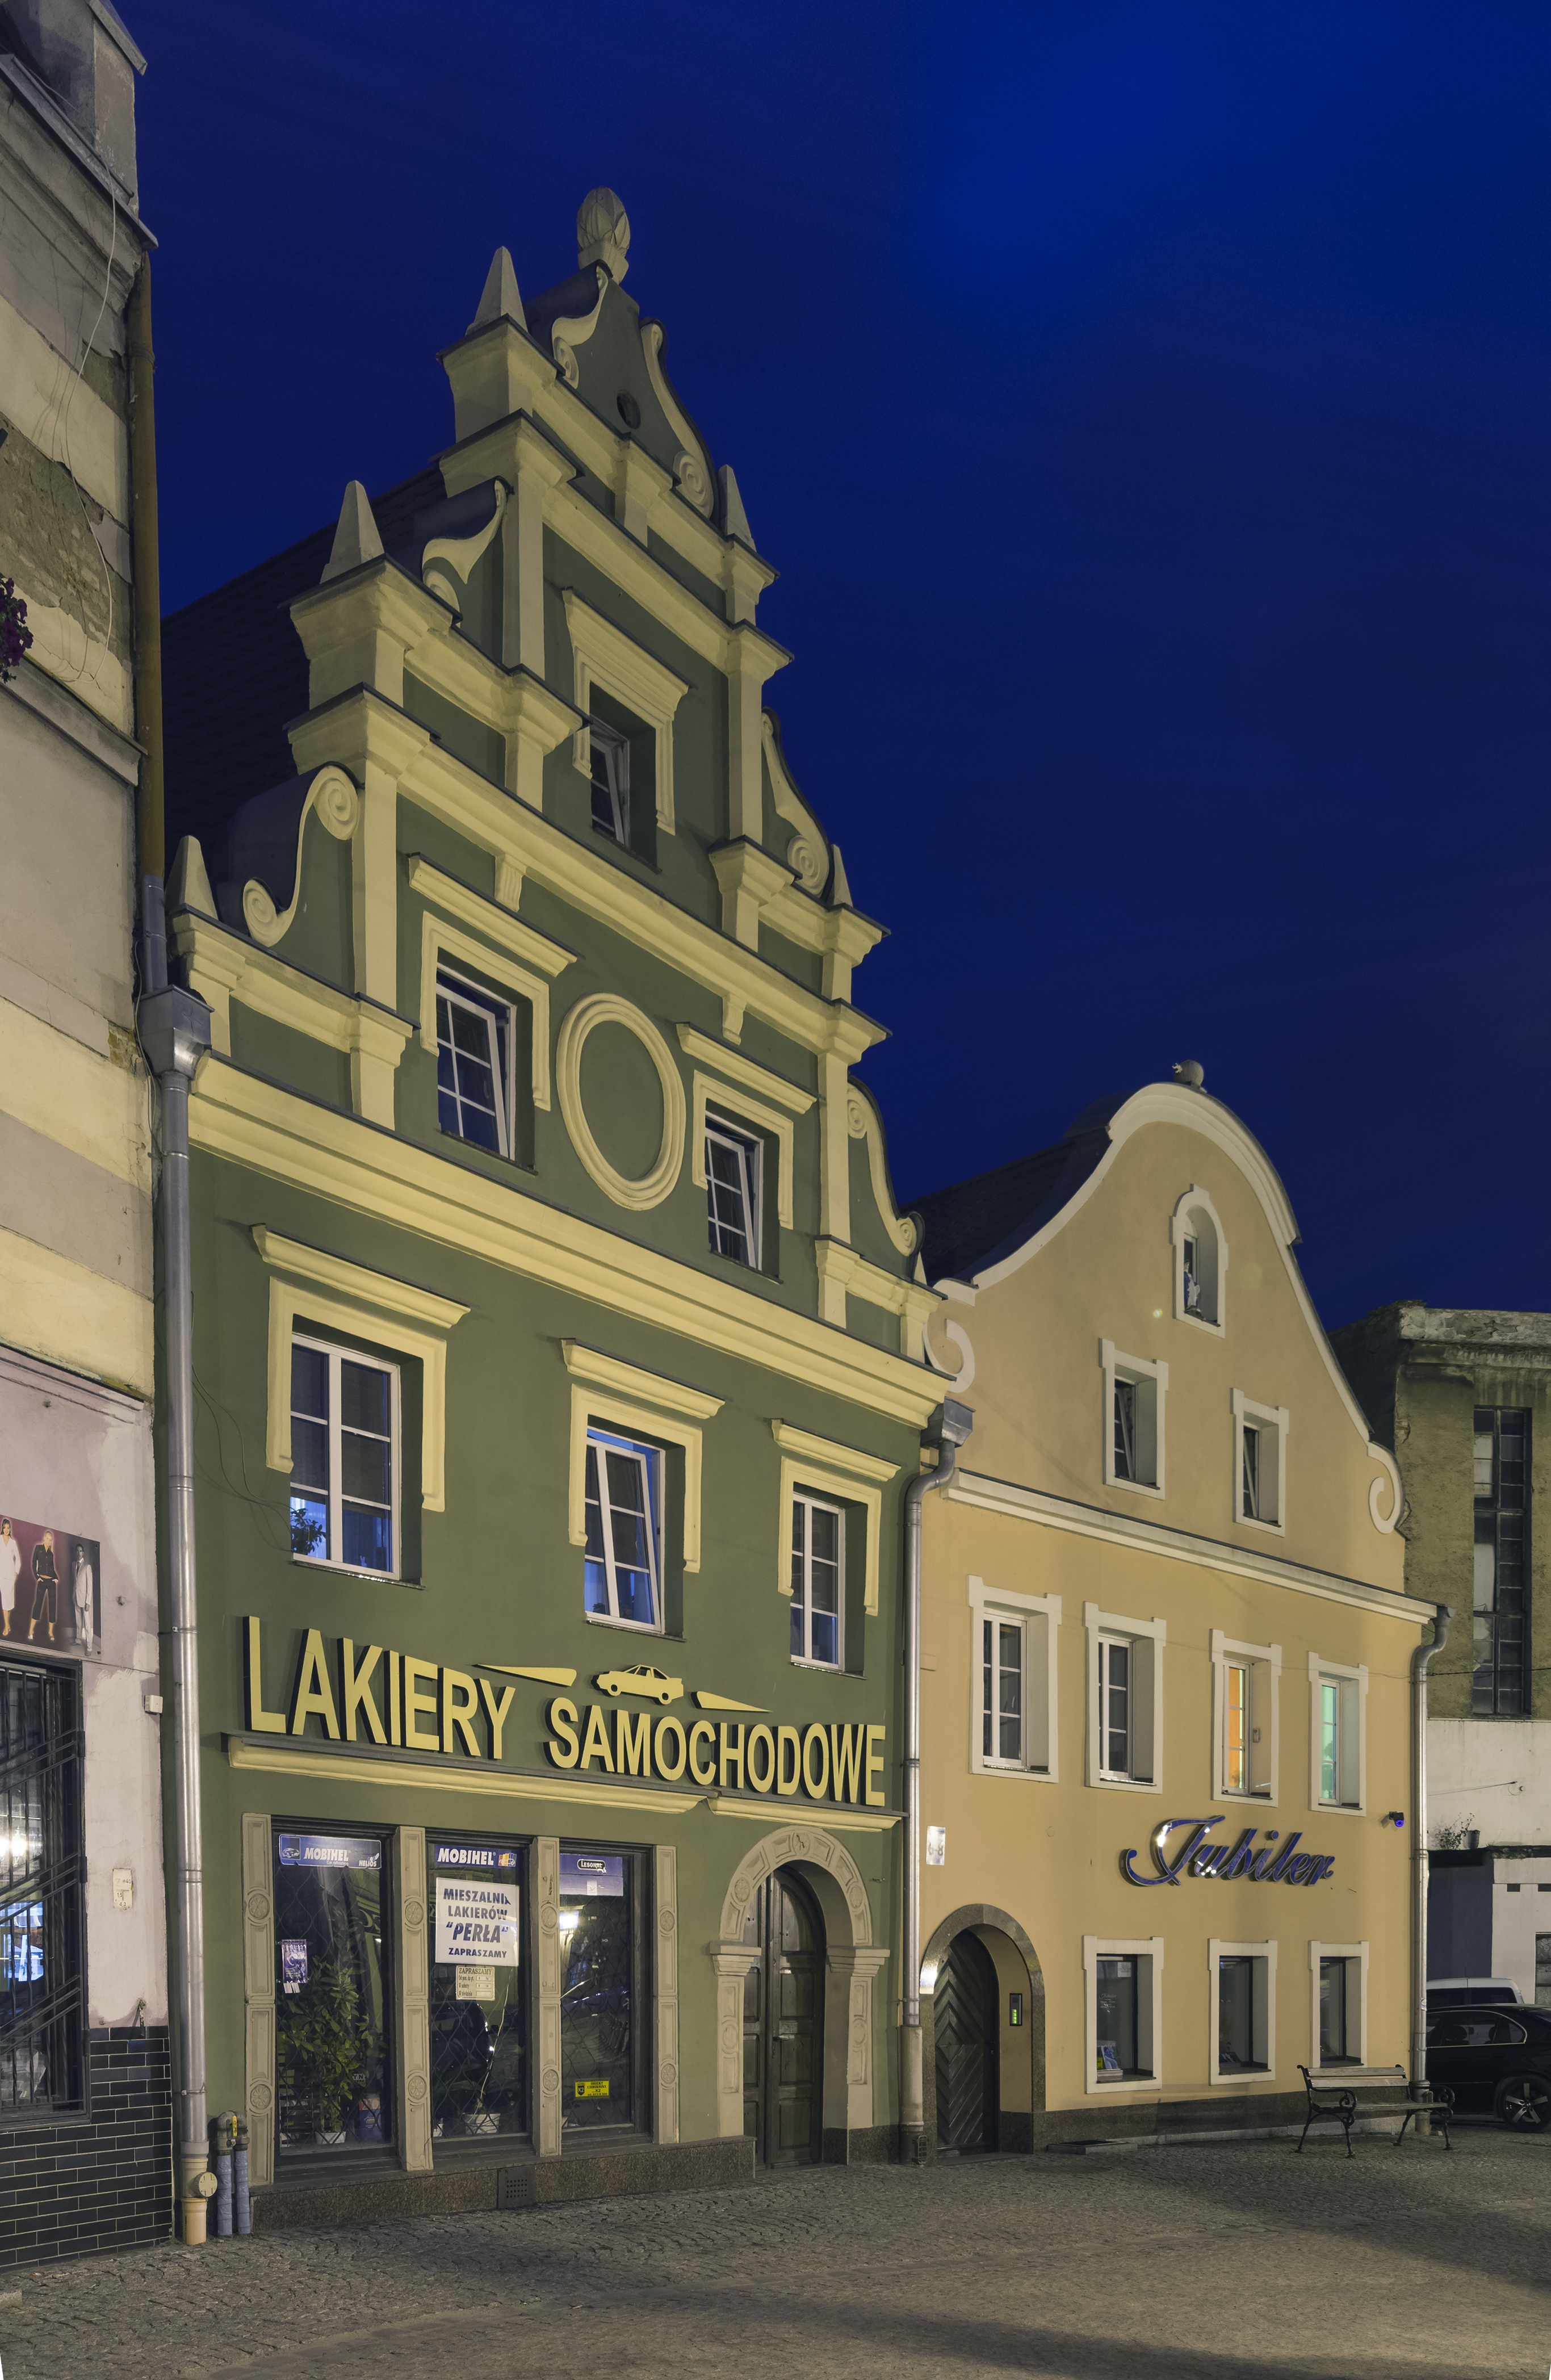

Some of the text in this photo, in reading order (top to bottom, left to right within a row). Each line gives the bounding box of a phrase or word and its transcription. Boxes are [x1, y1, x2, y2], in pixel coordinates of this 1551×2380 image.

[244, 1615, 886, 1807] LAKIERY SAMOCHODOWE
[303, 1847, 349, 1862] MOBIHEL
[437, 1847, 494, 1866] MOBIHEL
[1123, 1815, 1336, 1886] Jubiler
[448, 1905, 508, 1921] LAKIERÓW
[448, 1947, 507, 1958] ZAPRASZAMY
